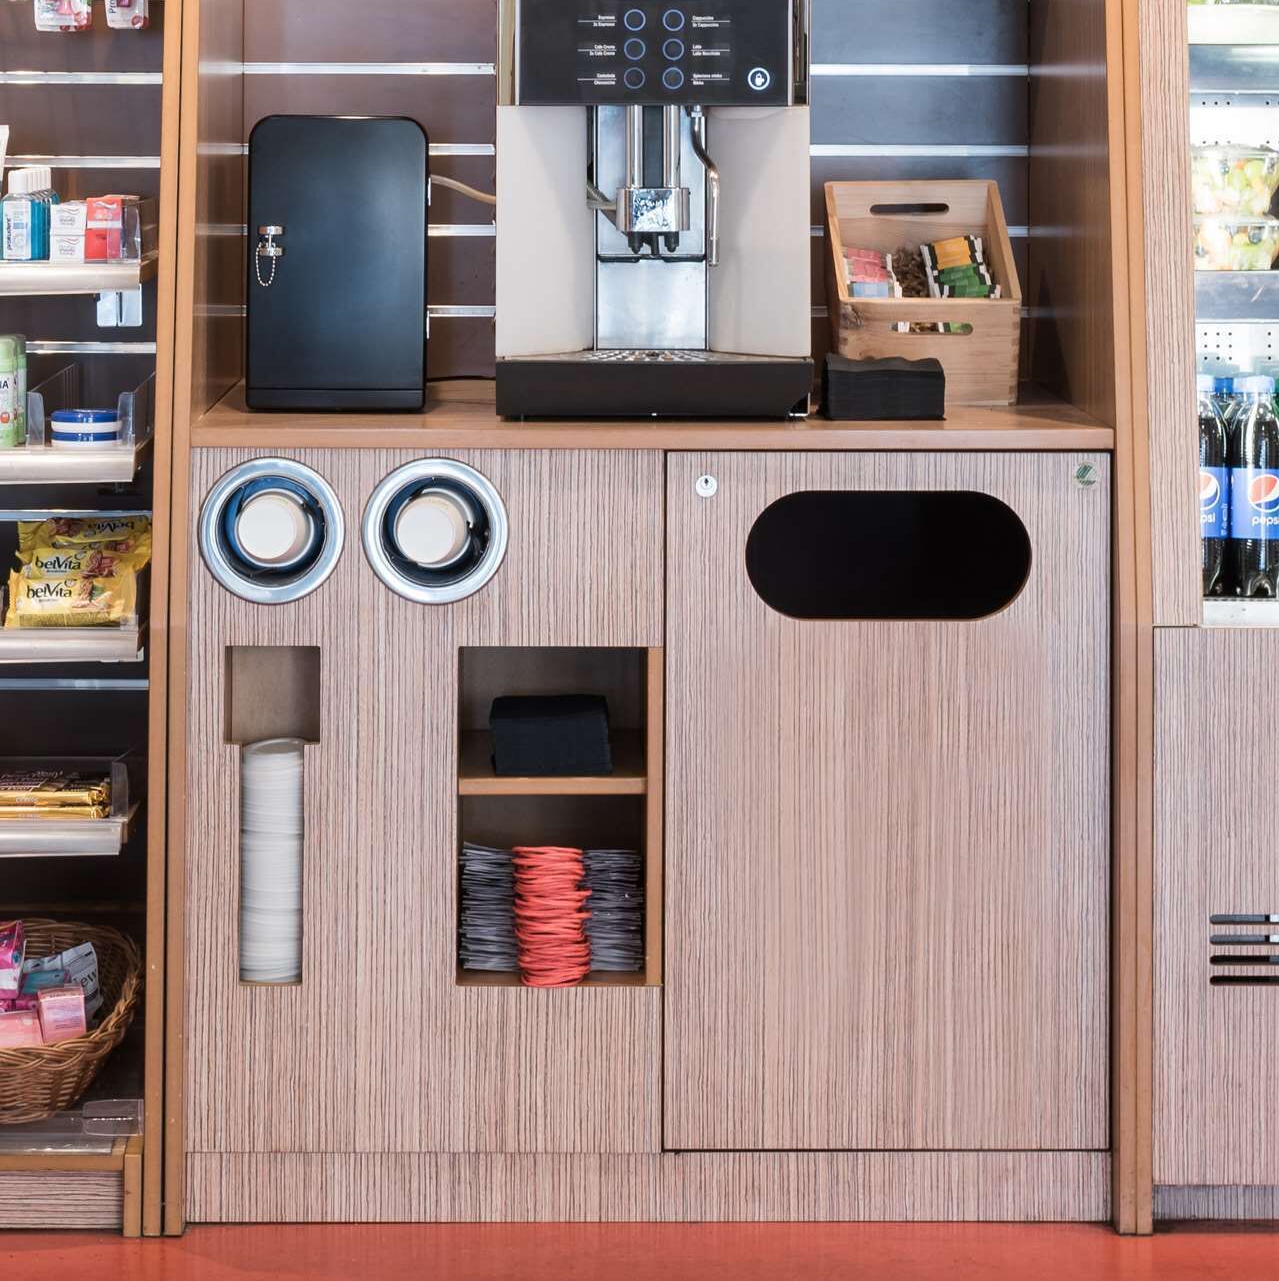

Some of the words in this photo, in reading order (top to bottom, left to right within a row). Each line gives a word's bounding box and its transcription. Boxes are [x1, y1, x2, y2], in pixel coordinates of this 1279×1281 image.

[1201, 512, 1216, 524] psi
[35, 554, 82, 570] belVita
[26, 582, 73, 598] belVita
